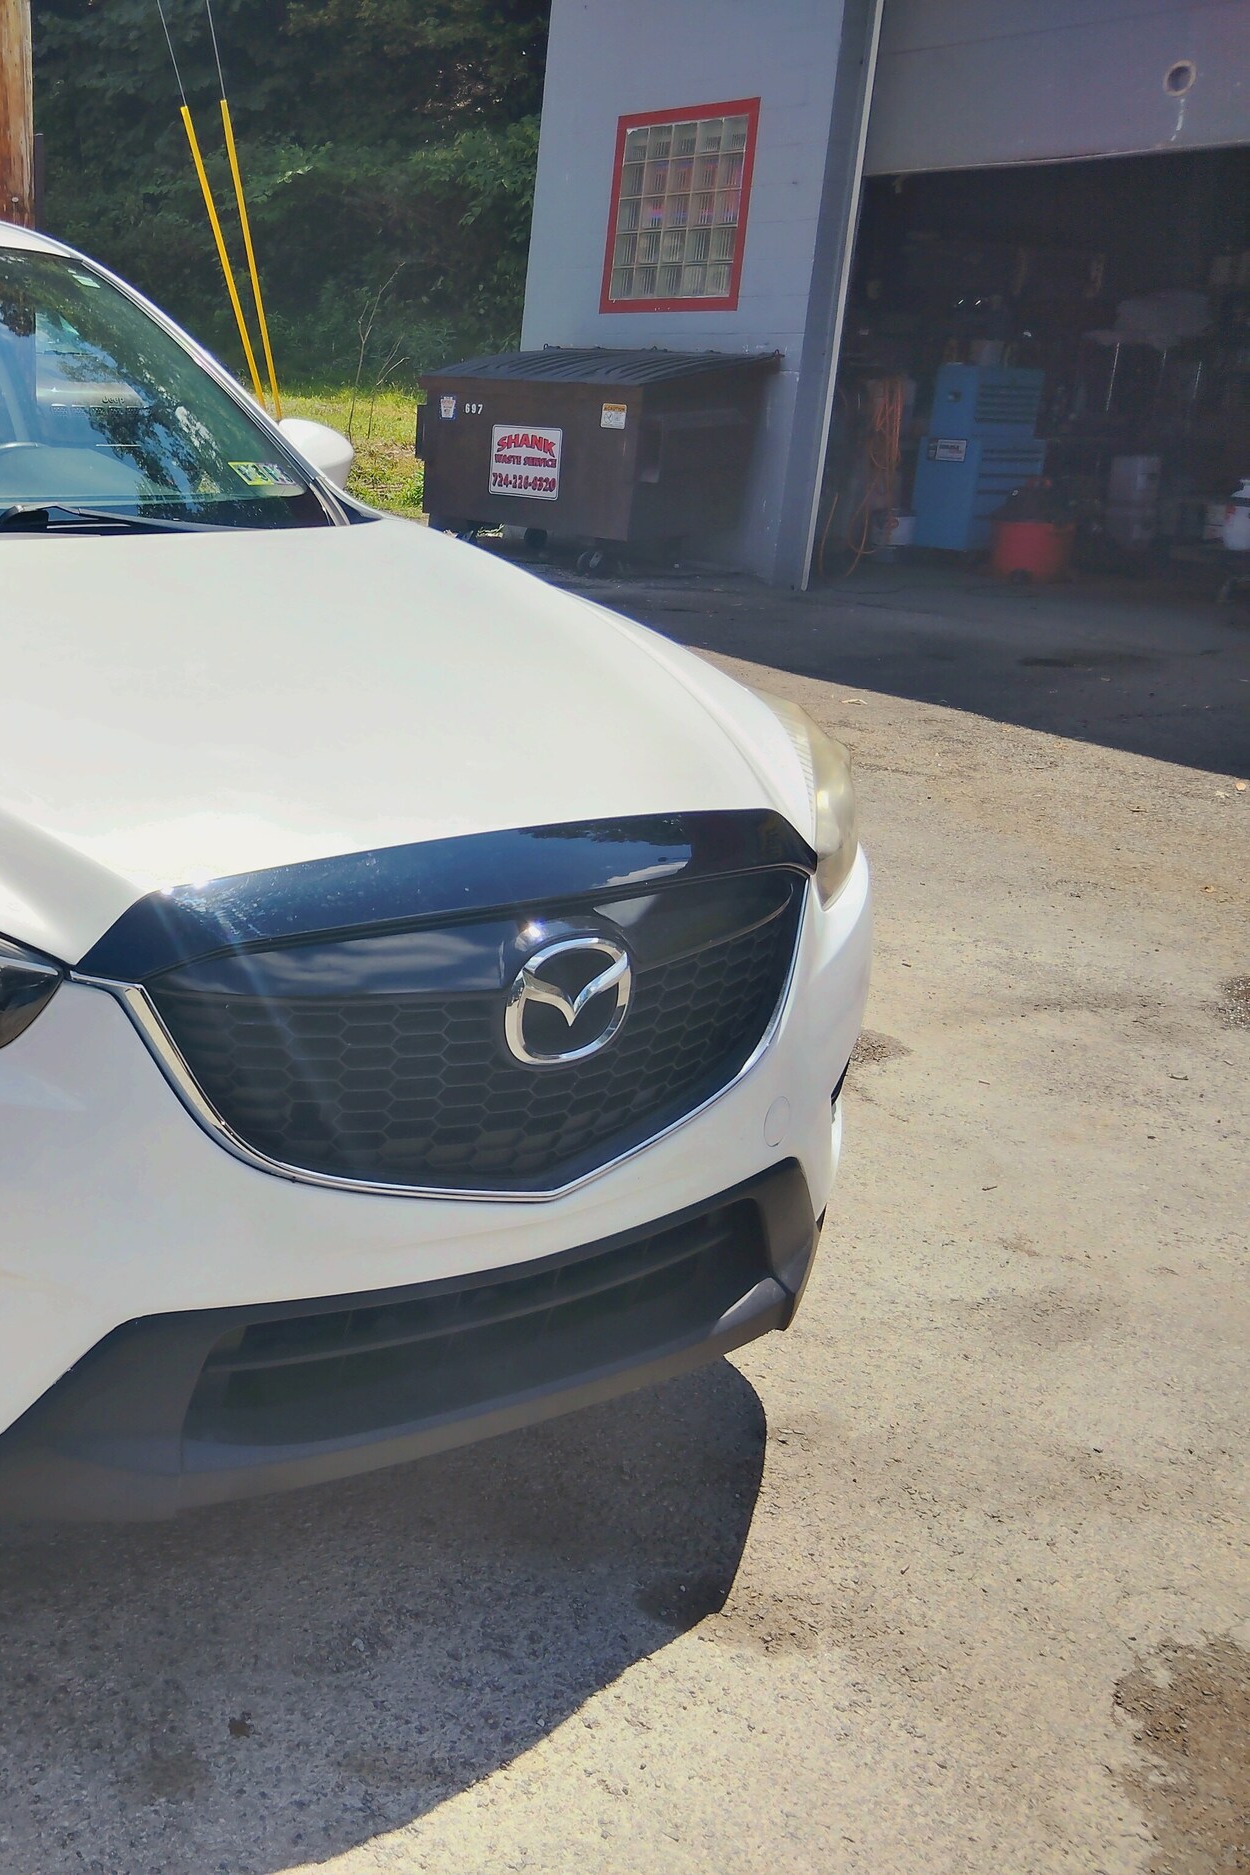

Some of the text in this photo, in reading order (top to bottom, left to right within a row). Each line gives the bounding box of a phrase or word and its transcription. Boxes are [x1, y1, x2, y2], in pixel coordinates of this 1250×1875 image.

[465, 403, 483, 414] 697
[497, 434, 556, 458] SHANK
[495, 454, 557, 468] WASTE SERVICE
